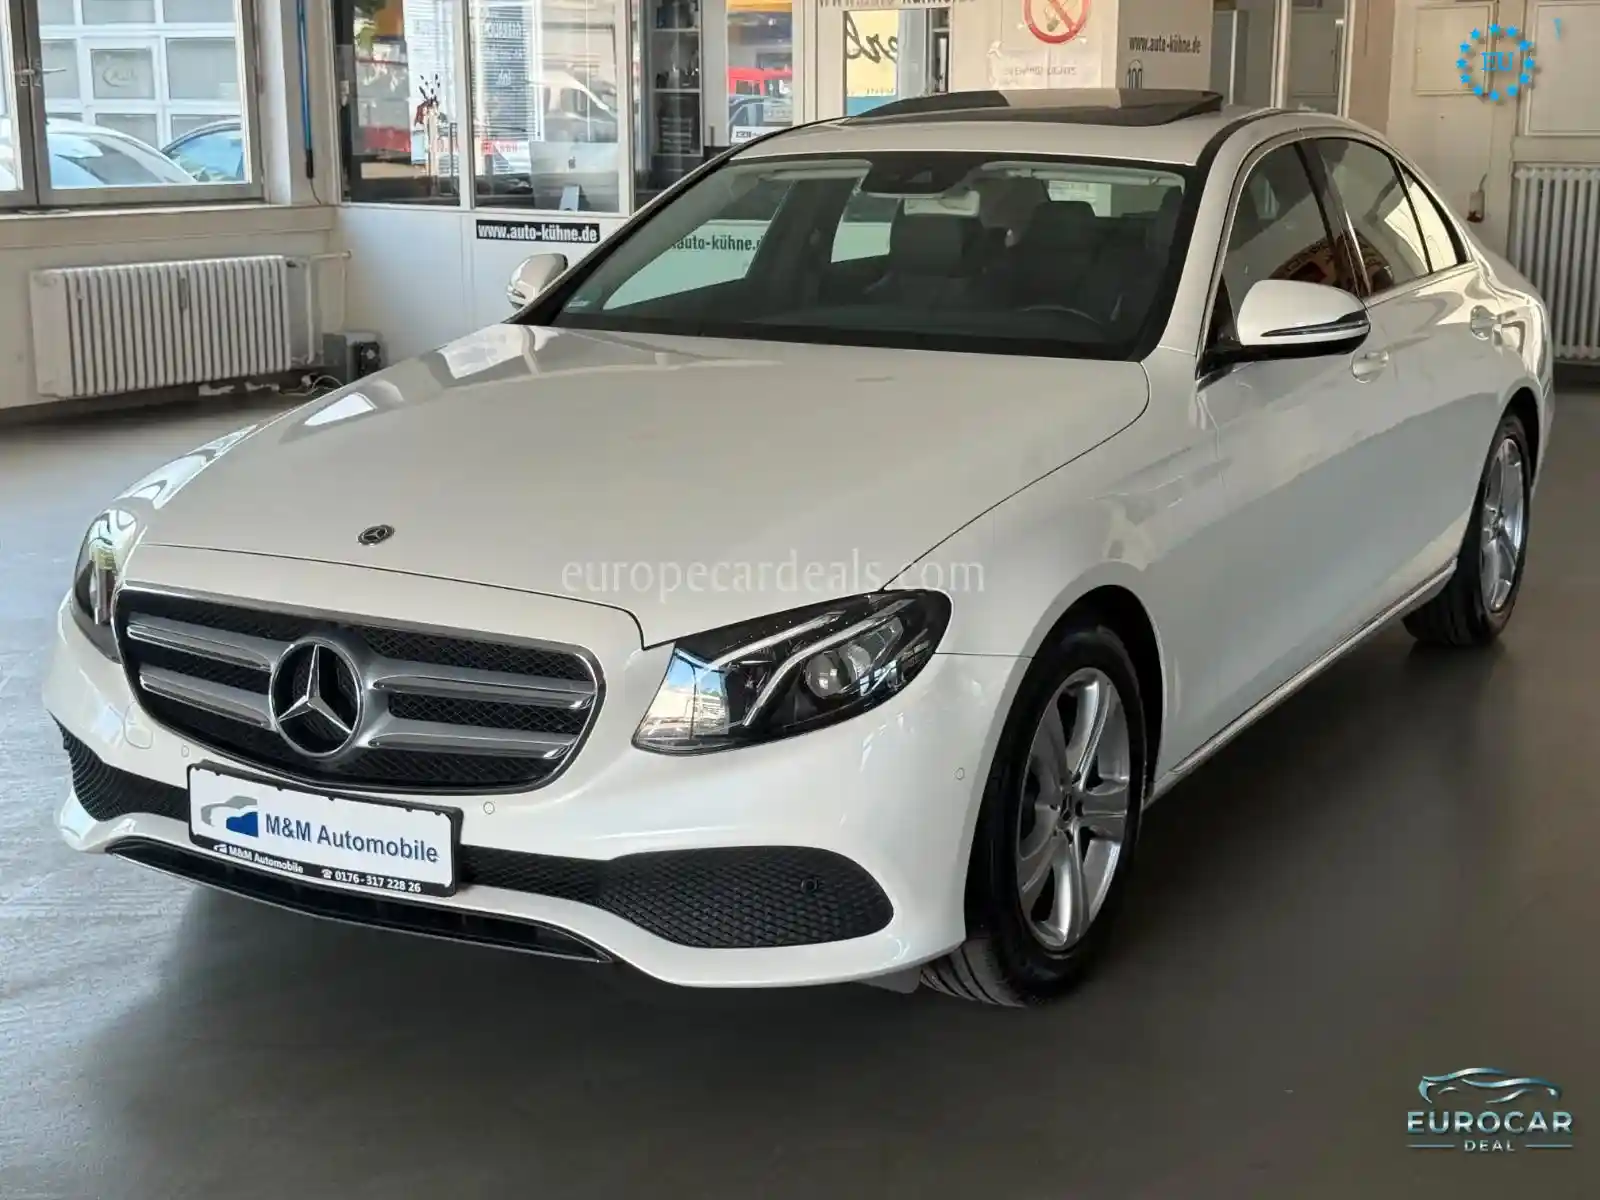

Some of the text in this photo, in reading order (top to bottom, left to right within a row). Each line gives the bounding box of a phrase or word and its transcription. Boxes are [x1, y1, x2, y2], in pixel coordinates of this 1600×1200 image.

[1128, 34, 1202, 54] www.auto-kühne.de
[477, 222, 598, 243] www.auto-kühne.de
[265, 814, 439, 863] M&M Automobile
[228, 847, 304, 874] M&M Automobile
[386, 878, 406, 891] 228
[408, 881, 421, 893] 26
